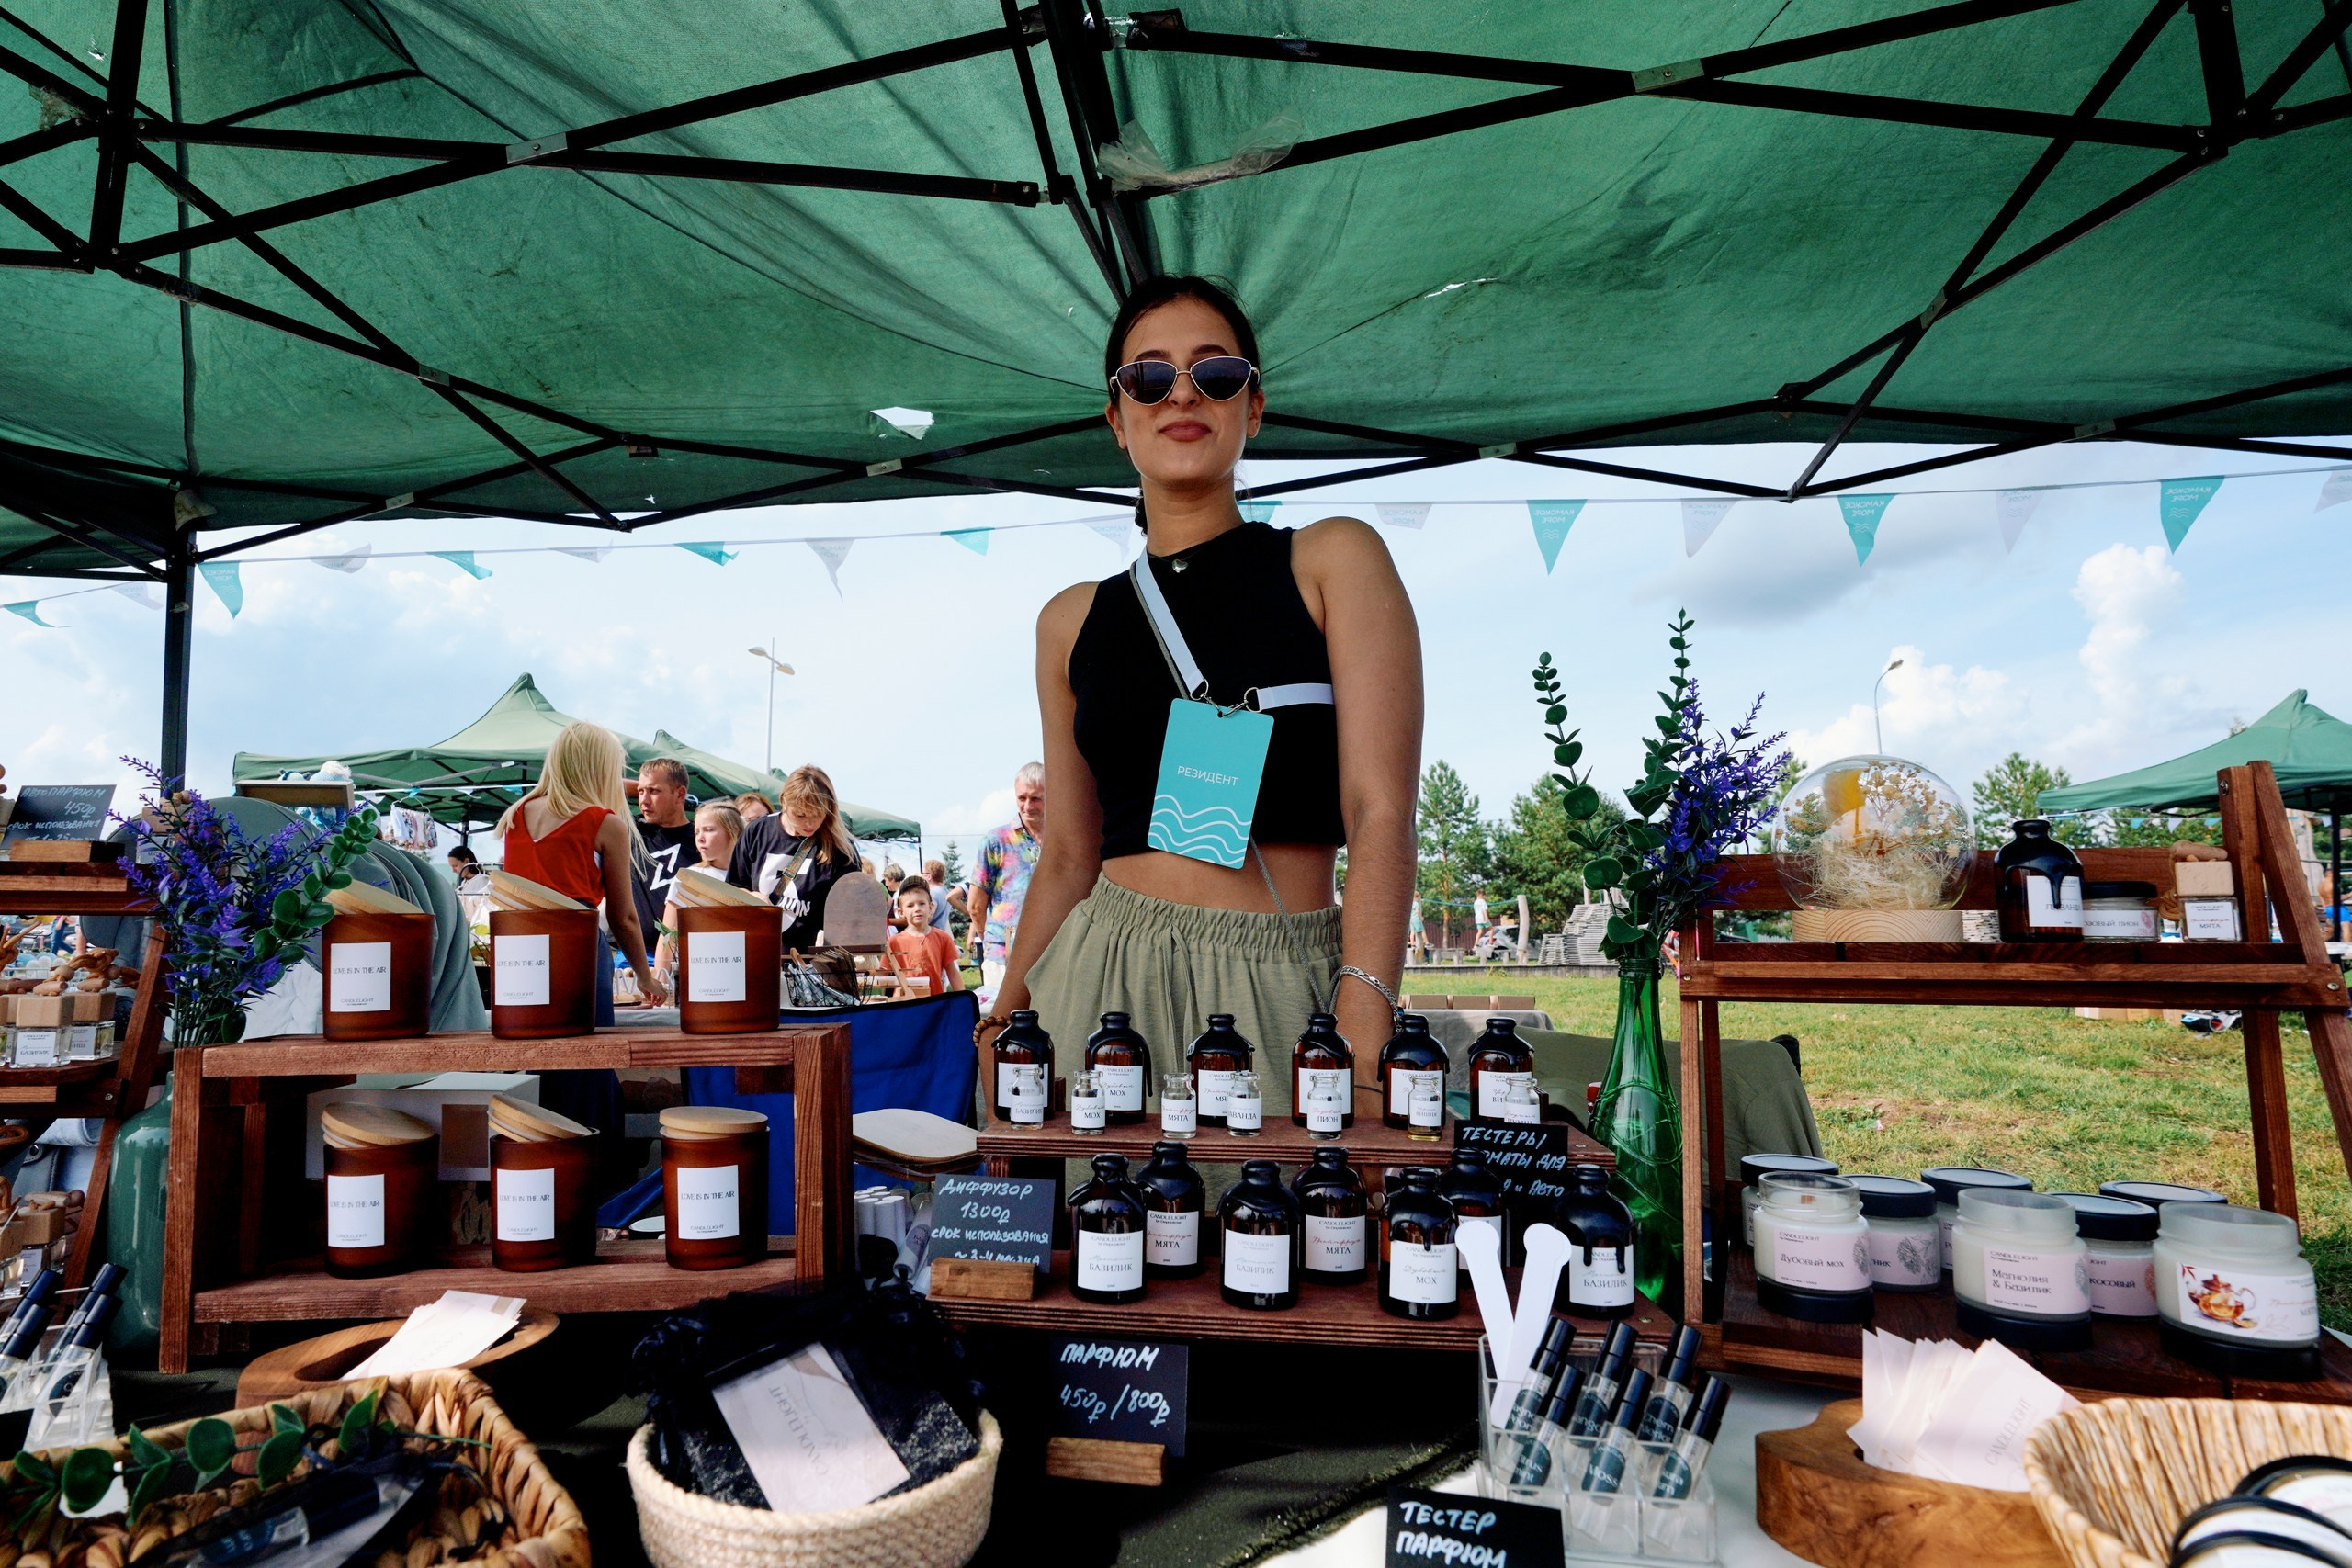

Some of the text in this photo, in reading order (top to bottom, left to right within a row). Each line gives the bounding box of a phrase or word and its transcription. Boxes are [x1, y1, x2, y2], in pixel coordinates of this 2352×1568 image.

[1177, 765, 1239, 786] РЕЗИДЕНТ
[1463, 1126, 1547, 1150] ТЕСТЕРЫ
[1536, 1154, 1566, 1171] ДЛЯ
[1529, 1179, 1565, 1197] АВТО
[1779, 1231, 1820, 1241] CANDLELIGHT
[1155, 1240, 1180, 1248] МЯТА
[1326, 1247, 1351, 1255] МЯТА
[1781, 1253, 1824, 1267] Дубовый
[1990, 1251, 2038, 1261] CANDLELIGHT
[1090, 1263, 1134, 1272] БАЗИЛИК
[1236, 1264, 1275, 1275] БАЗИЛИК
[1416, 1276, 1437, 1285] МОХ
[1584, 1279, 1628, 1288] БАЗИЛИК
[1992, 1269, 2049, 1284] Магнолия
[2089, 1278, 2136, 1288] косовый
[1993, 1279, 2052, 1294] & Базилик
[1060, 1343, 1159, 1371] ПАРФЮМ
[768, 1384, 829, 1476] CANDLELIGHT
[1984, 1397, 2031, 1467] CANDLELIGHT
[1399, 1500, 1497, 1536] ТЕСТЕР
[1396, 1530, 1508, 1568] ПАРФЮМ
